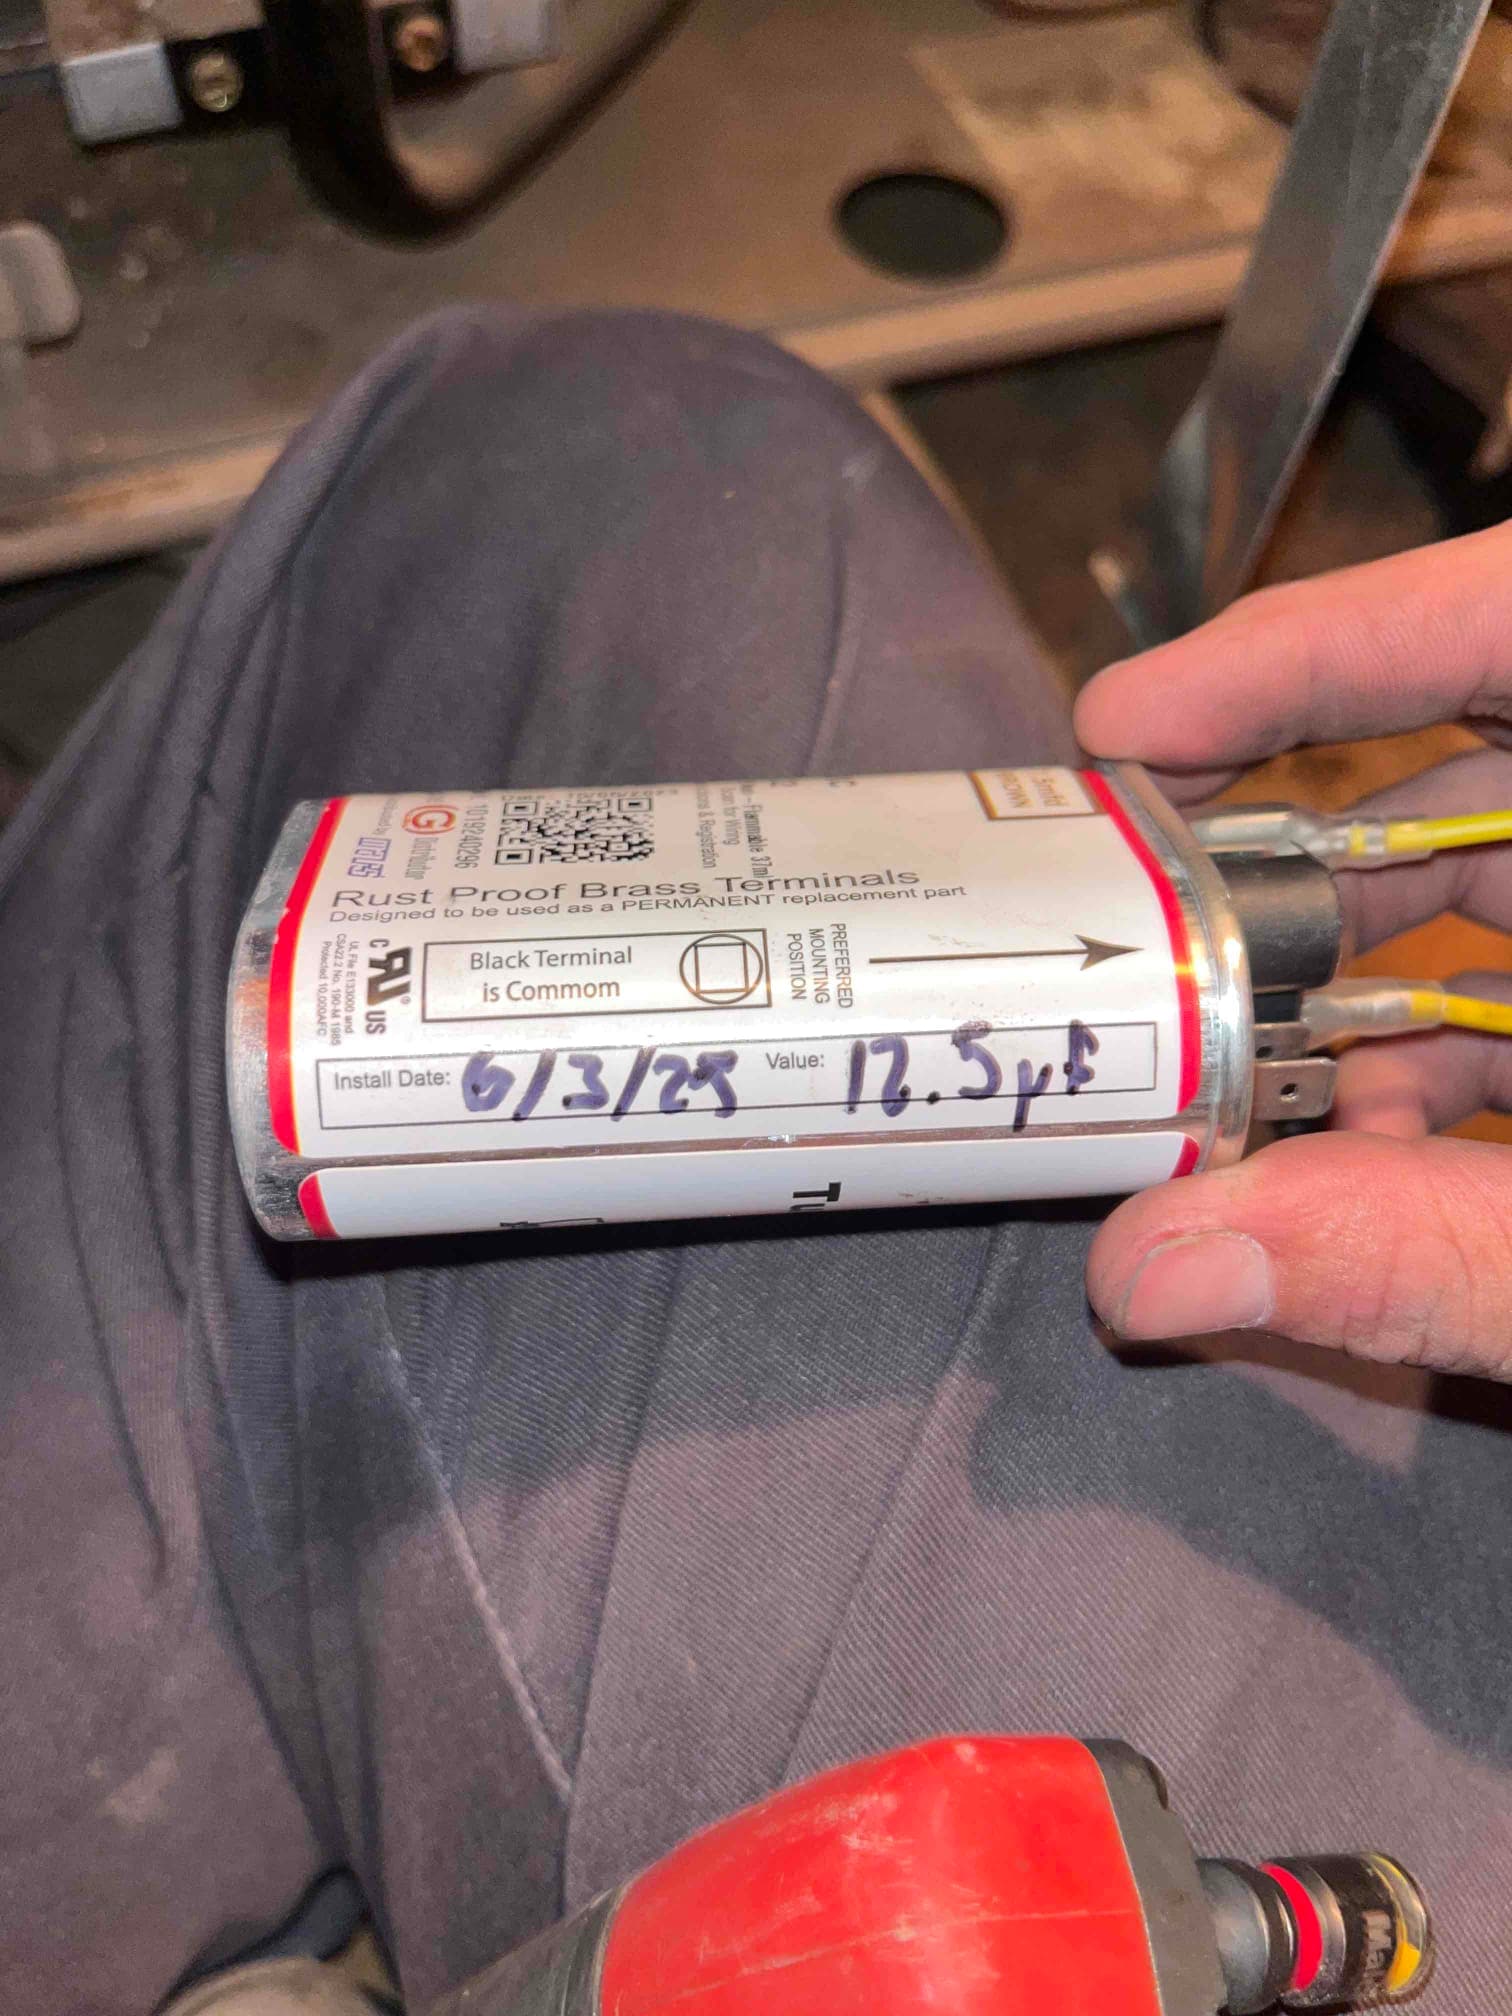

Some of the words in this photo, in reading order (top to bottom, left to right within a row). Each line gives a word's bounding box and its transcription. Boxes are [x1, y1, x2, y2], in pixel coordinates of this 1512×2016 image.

[695, 819, 719, 868] Registration
[332, 888, 434, 907] Rust
[450, 883, 567, 904] Proof
[580, 881, 701, 899] Brass
[715, 869, 920, 893] Terminals
[329, 908, 435, 923] Designed
[444, 907, 464, 918] to
[472, 905, 498, 917] be
[507, 903, 560, 916] used
[567, 903, 593, 913] as
[601, 903, 614, 912] a
[622, 894, 776, 911] PERMANENT
[782, 887, 918, 906] replacement
[924, 885, 967, 900] part
[319, 941, 332, 980] Protected
[347, 954, 358, 968] File
[349, 941, 360, 951] UL
[470, 950, 530, 970] Black
[534, 945, 632, 967] Terminal
[786, 933, 807, 1000] POSITION
[808, 928, 830, 1004] MOUNTING
[830, 923, 853, 1008] PREFERRED
[344, 971, 357, 1012] E133000
[482, 983, 500, 1002] is
[506, 980, 620, 1001] Commom
[344, 1015, 354, 1034] and
[365, 1010, 386, 1034] US
[765, 1051, 825, 1070] Value:
[334, 1070, 392, 1090] Install
[400, 1068, 451, 1089] Date:
